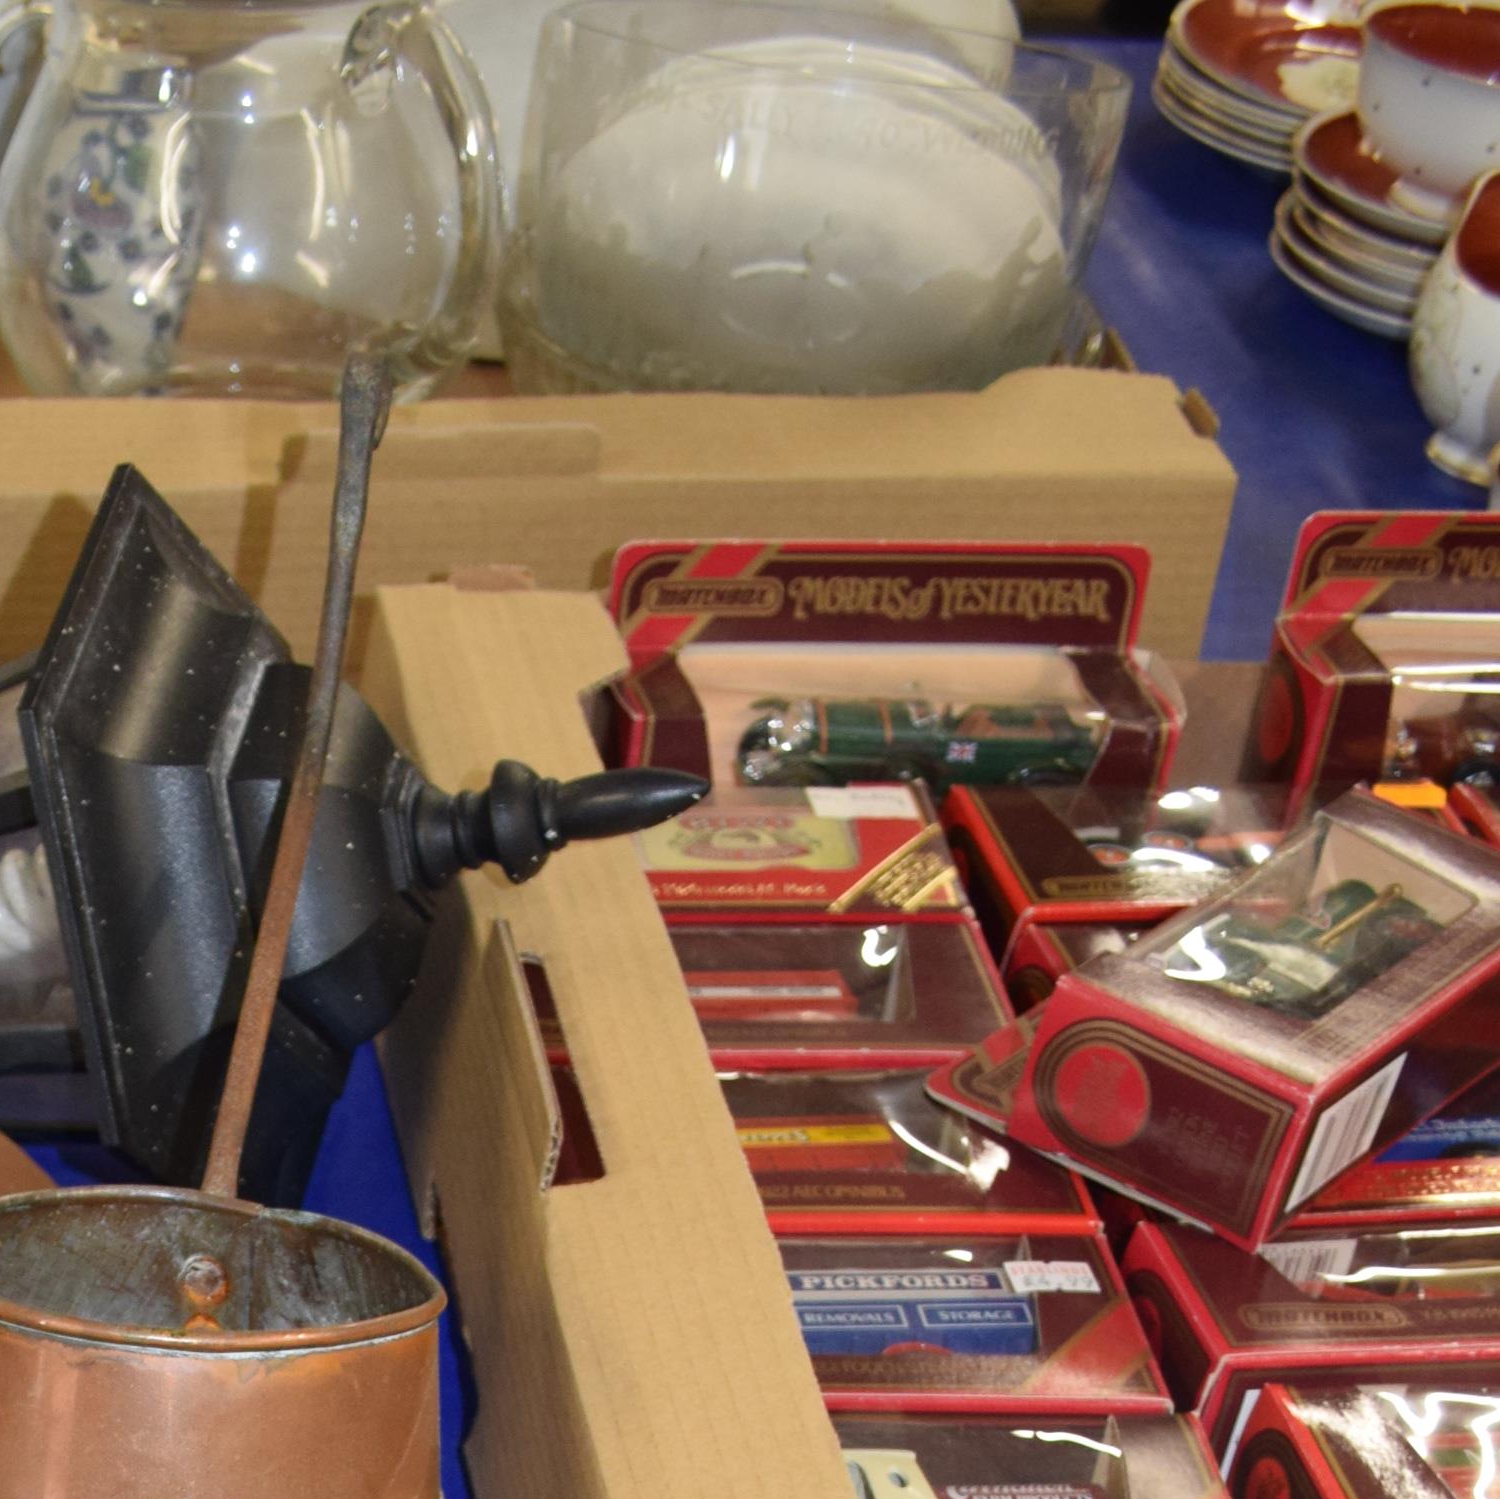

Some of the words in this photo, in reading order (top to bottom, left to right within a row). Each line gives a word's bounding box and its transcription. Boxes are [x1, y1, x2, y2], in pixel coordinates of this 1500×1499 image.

[787, 576, 913, 620] MODELS
[938, 577, 1112, 622] YESTERYEAR
[800, 1273, 988, 1291] PICKFORDS
[803, 1311, 895, 1325] REMOVALS
[938, 1308, 1014, 1322] STORAGE
